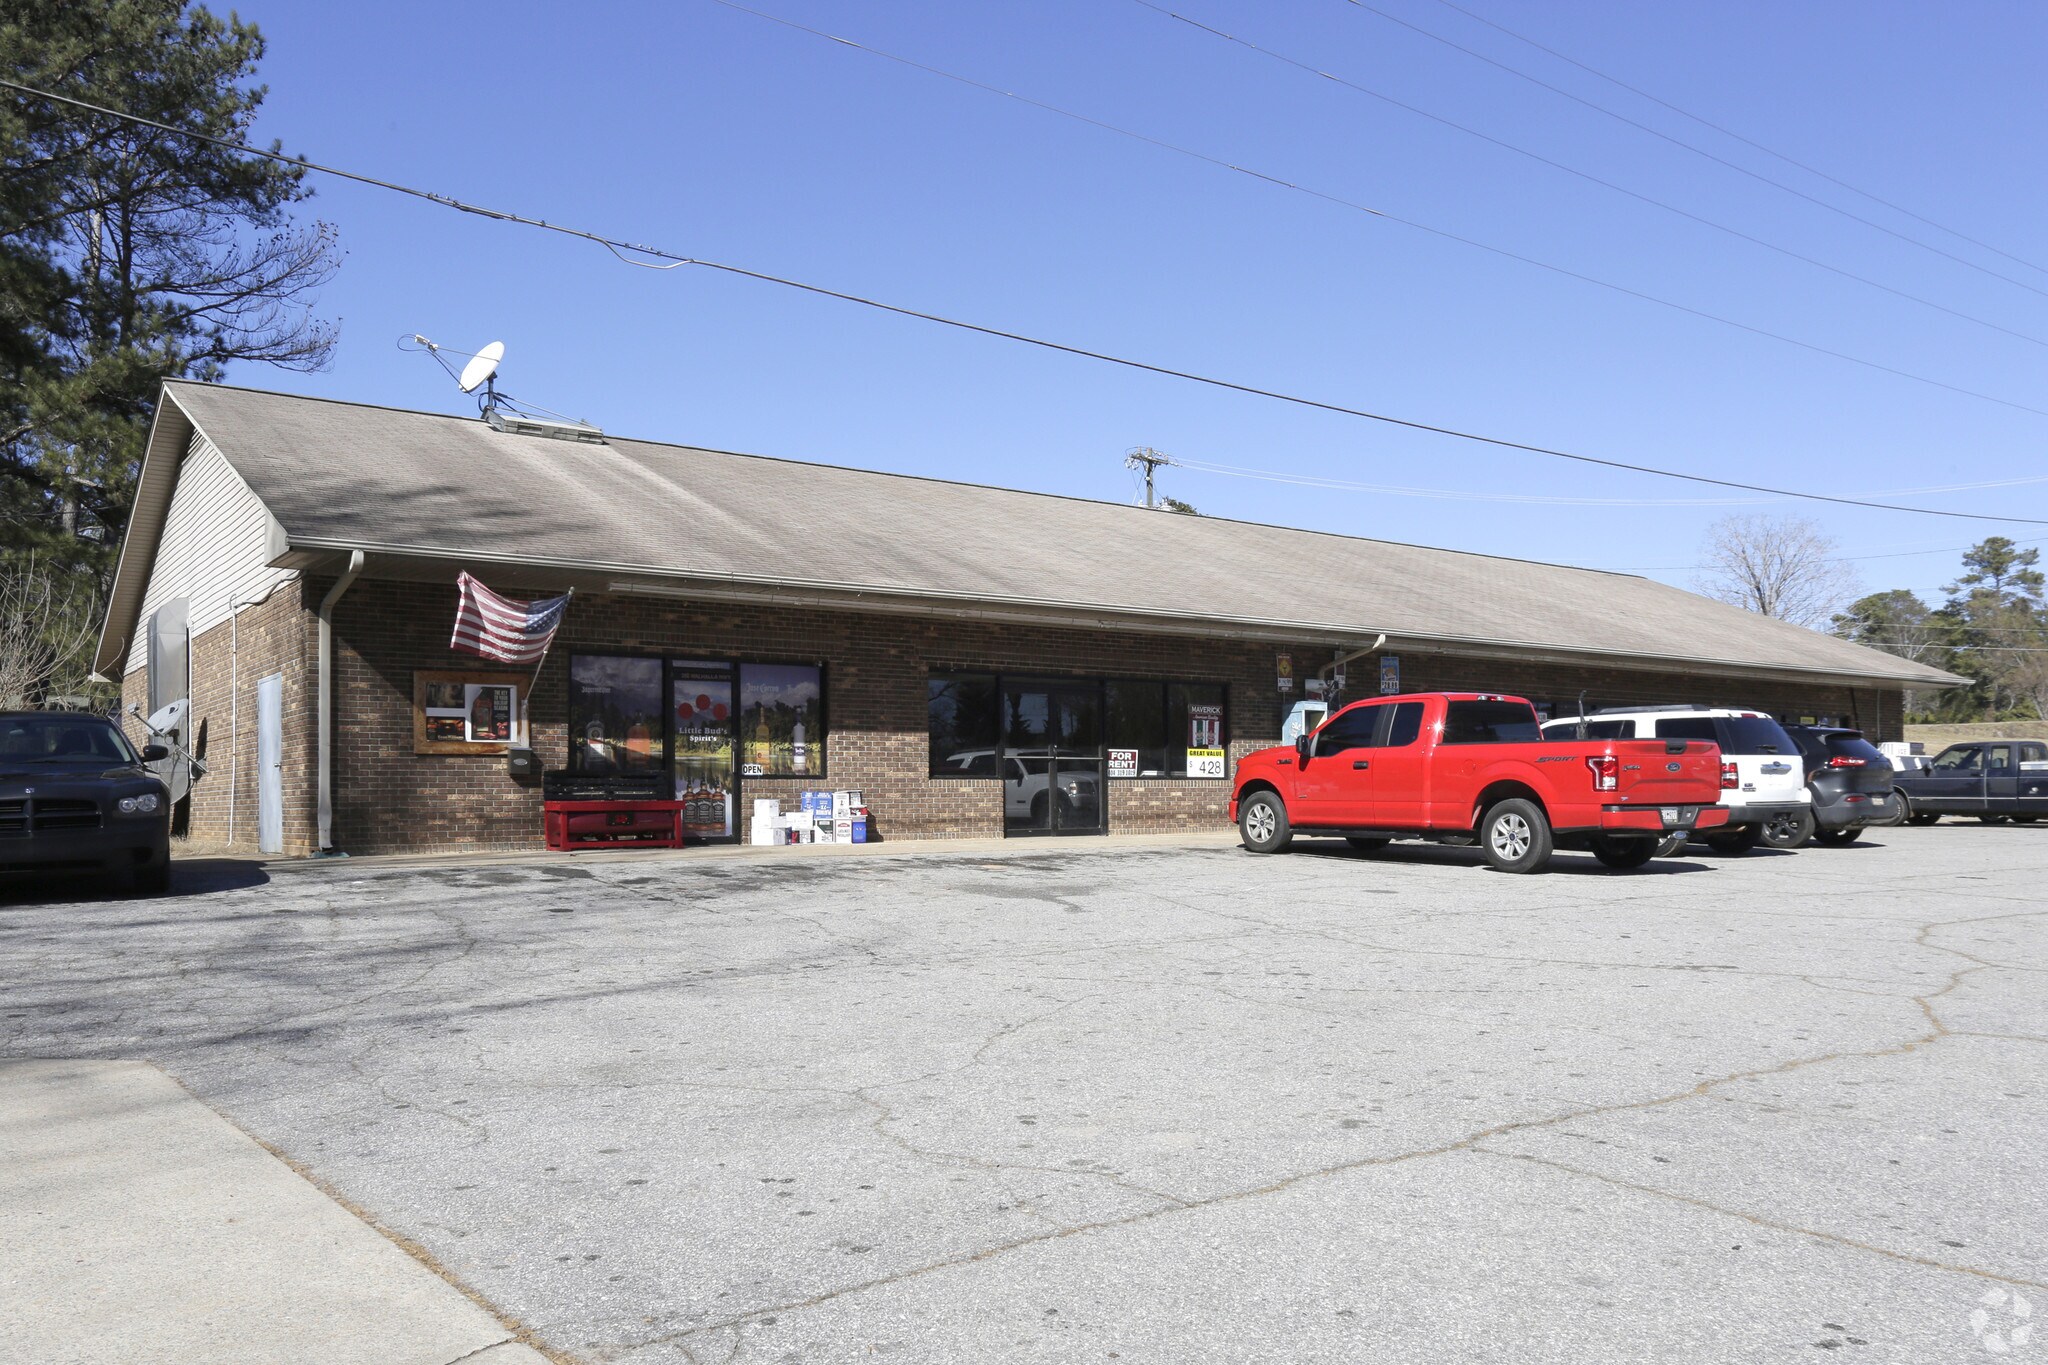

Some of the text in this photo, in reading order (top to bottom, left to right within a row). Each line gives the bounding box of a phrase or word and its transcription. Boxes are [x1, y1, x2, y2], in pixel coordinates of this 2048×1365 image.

[1191, 706, 1220, 714] MAVERICK
[1111, 752, 1132, 760] FOR
[1108, 760, 1135, 768] RENT
[742, 765, 762, 774] OPEN
